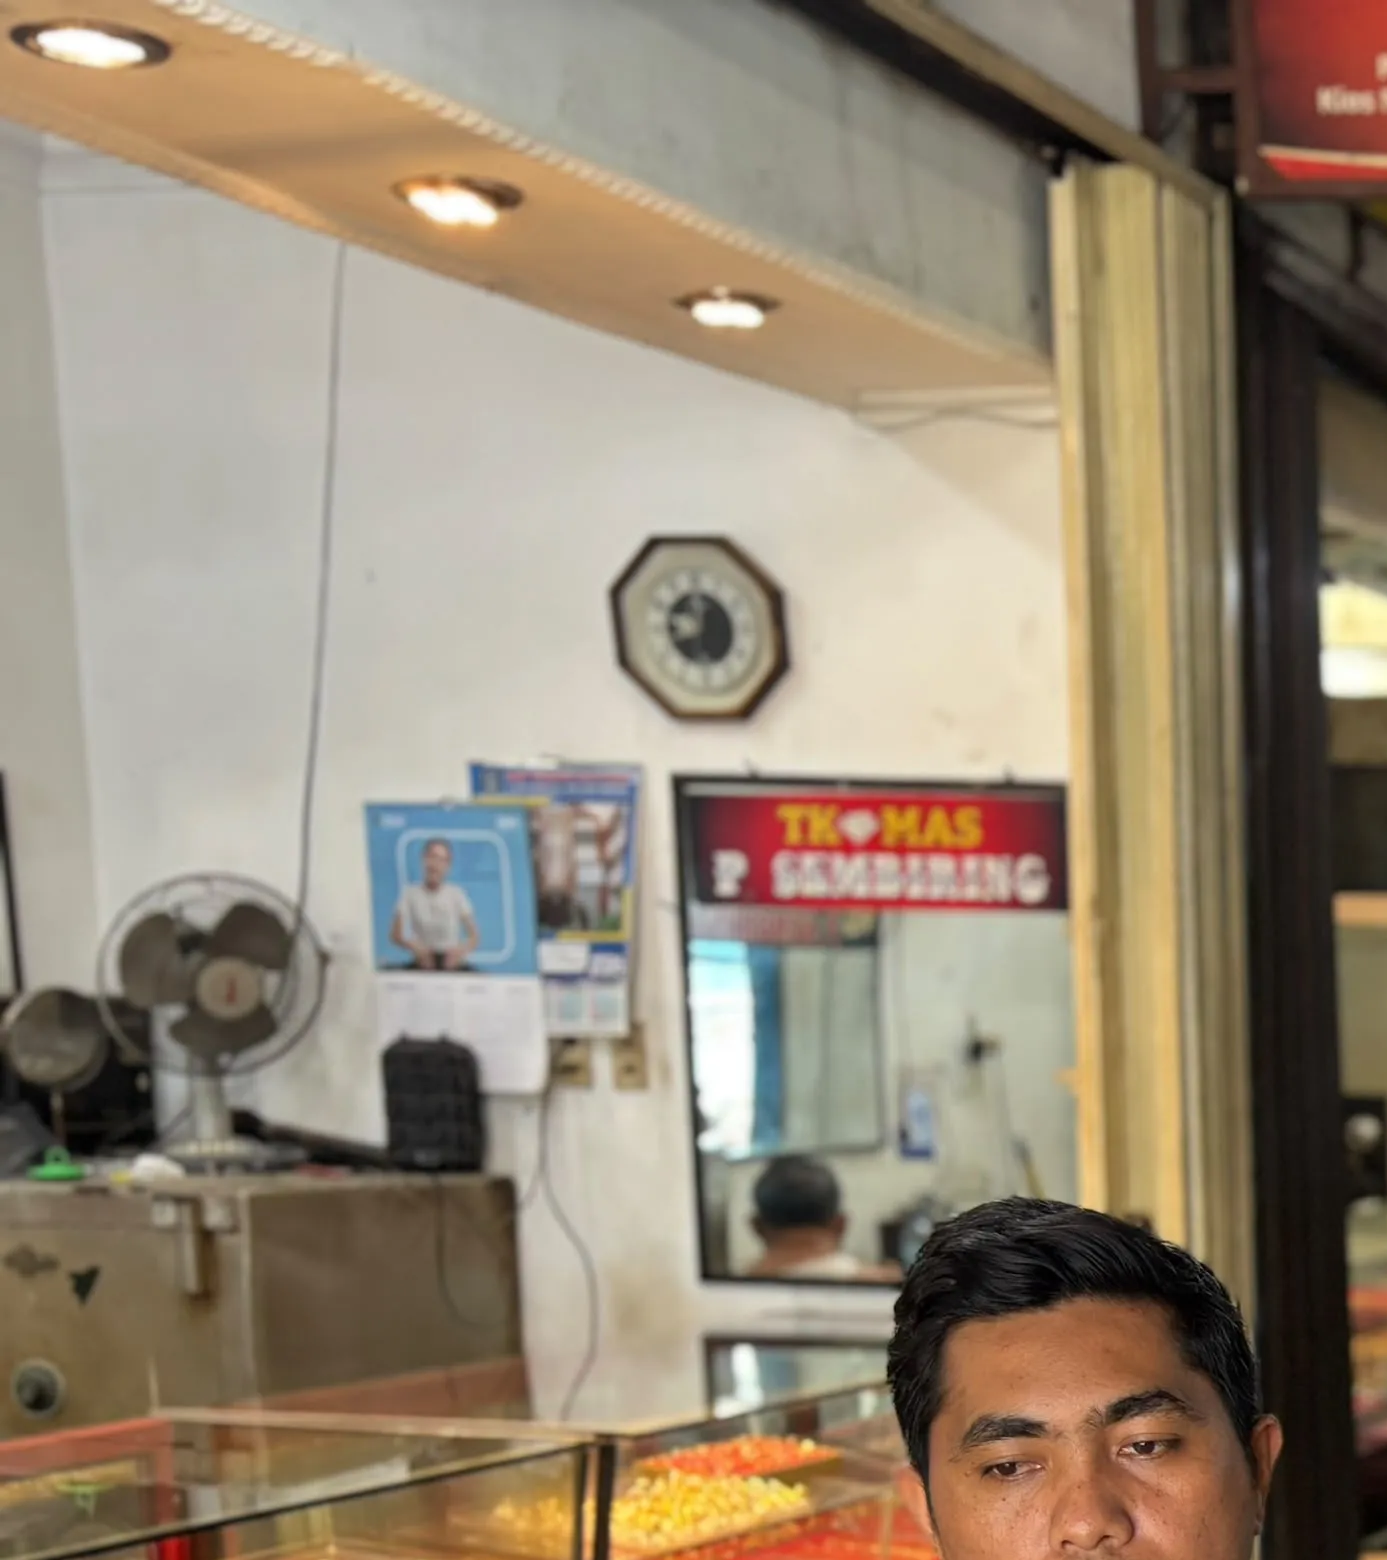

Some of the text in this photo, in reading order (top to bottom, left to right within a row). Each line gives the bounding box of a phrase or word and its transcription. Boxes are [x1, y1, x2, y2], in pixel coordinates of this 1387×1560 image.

[776, 804, 983, 848] TK MAS
[770, 850, 1051, 905] SEMBIRING
